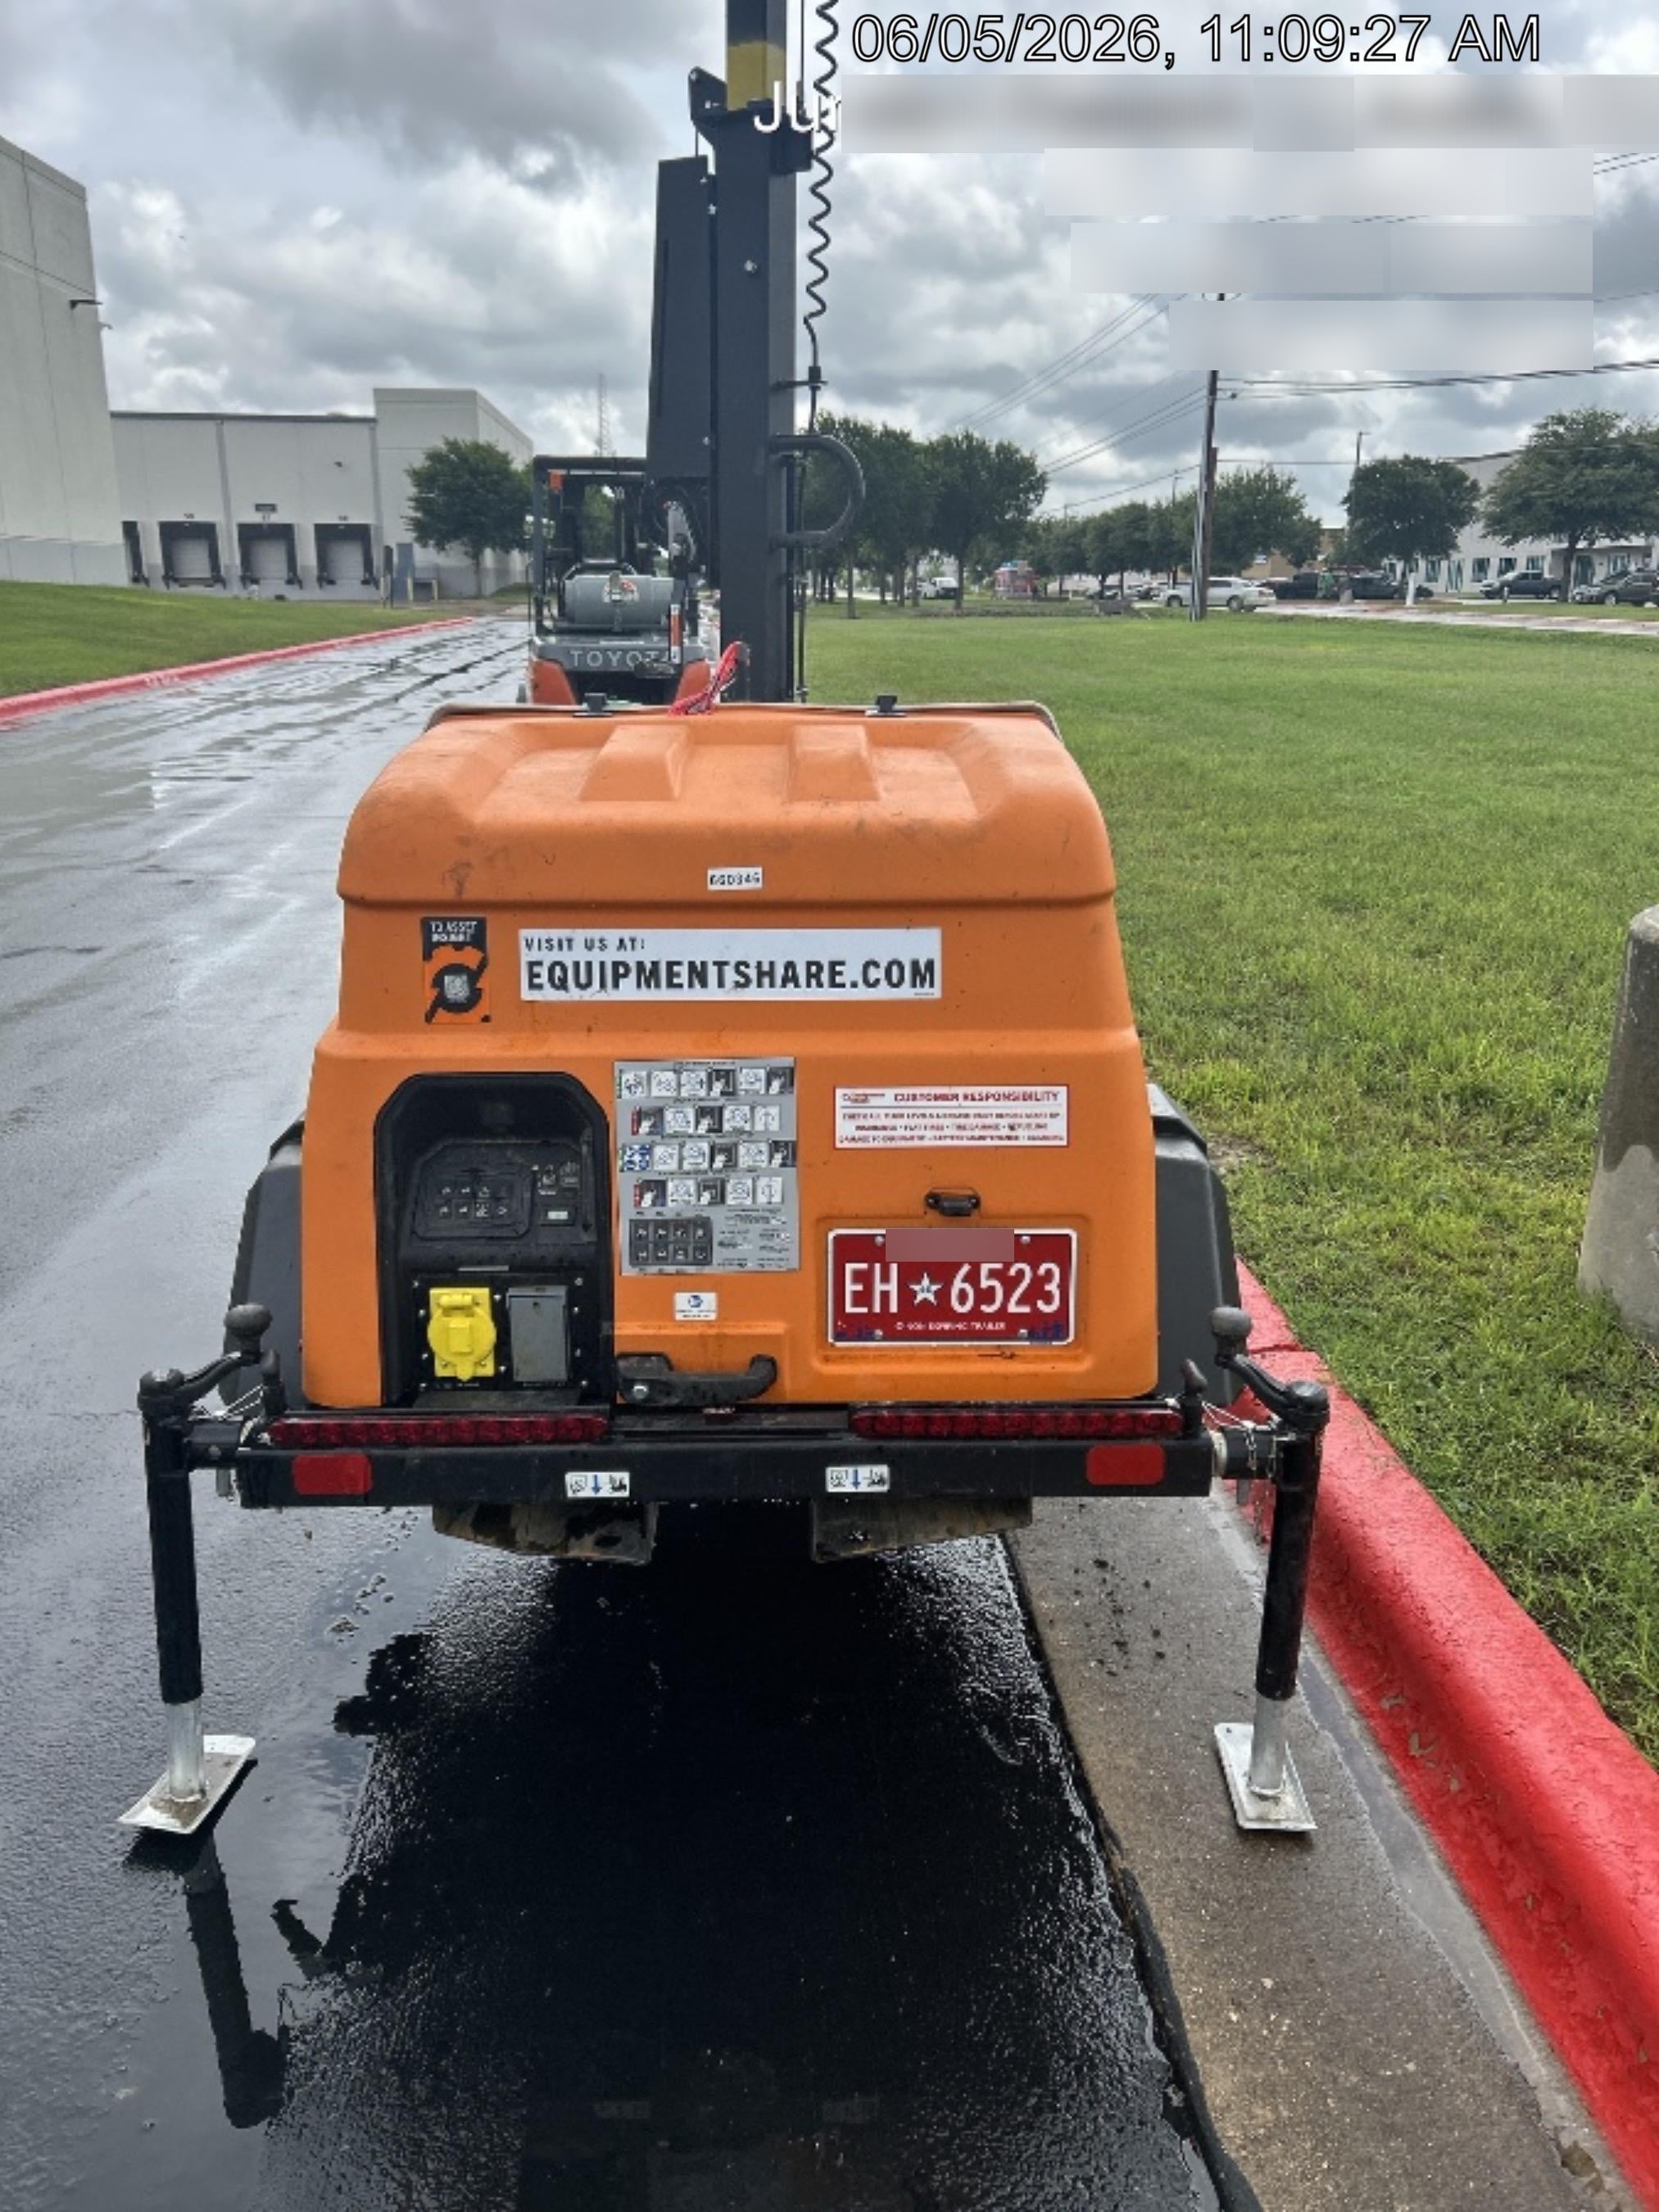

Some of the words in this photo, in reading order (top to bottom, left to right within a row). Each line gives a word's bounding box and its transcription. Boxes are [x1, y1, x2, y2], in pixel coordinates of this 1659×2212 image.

[524, 937, 573, 951] VISIT
[584, 937, 609, 951] US
[617, 936, 646, 951] AT:
[527, 959, 936, 991] EQUIPMENTSHARE.COM
[894, 1092, 959, 1103] CUSTOMER
[963, 1090, 1059, 1102] RESPONSIBILITY
[845, 1262, 899, 1314] EH
[950, 1262, 1062, 1314] 6523
